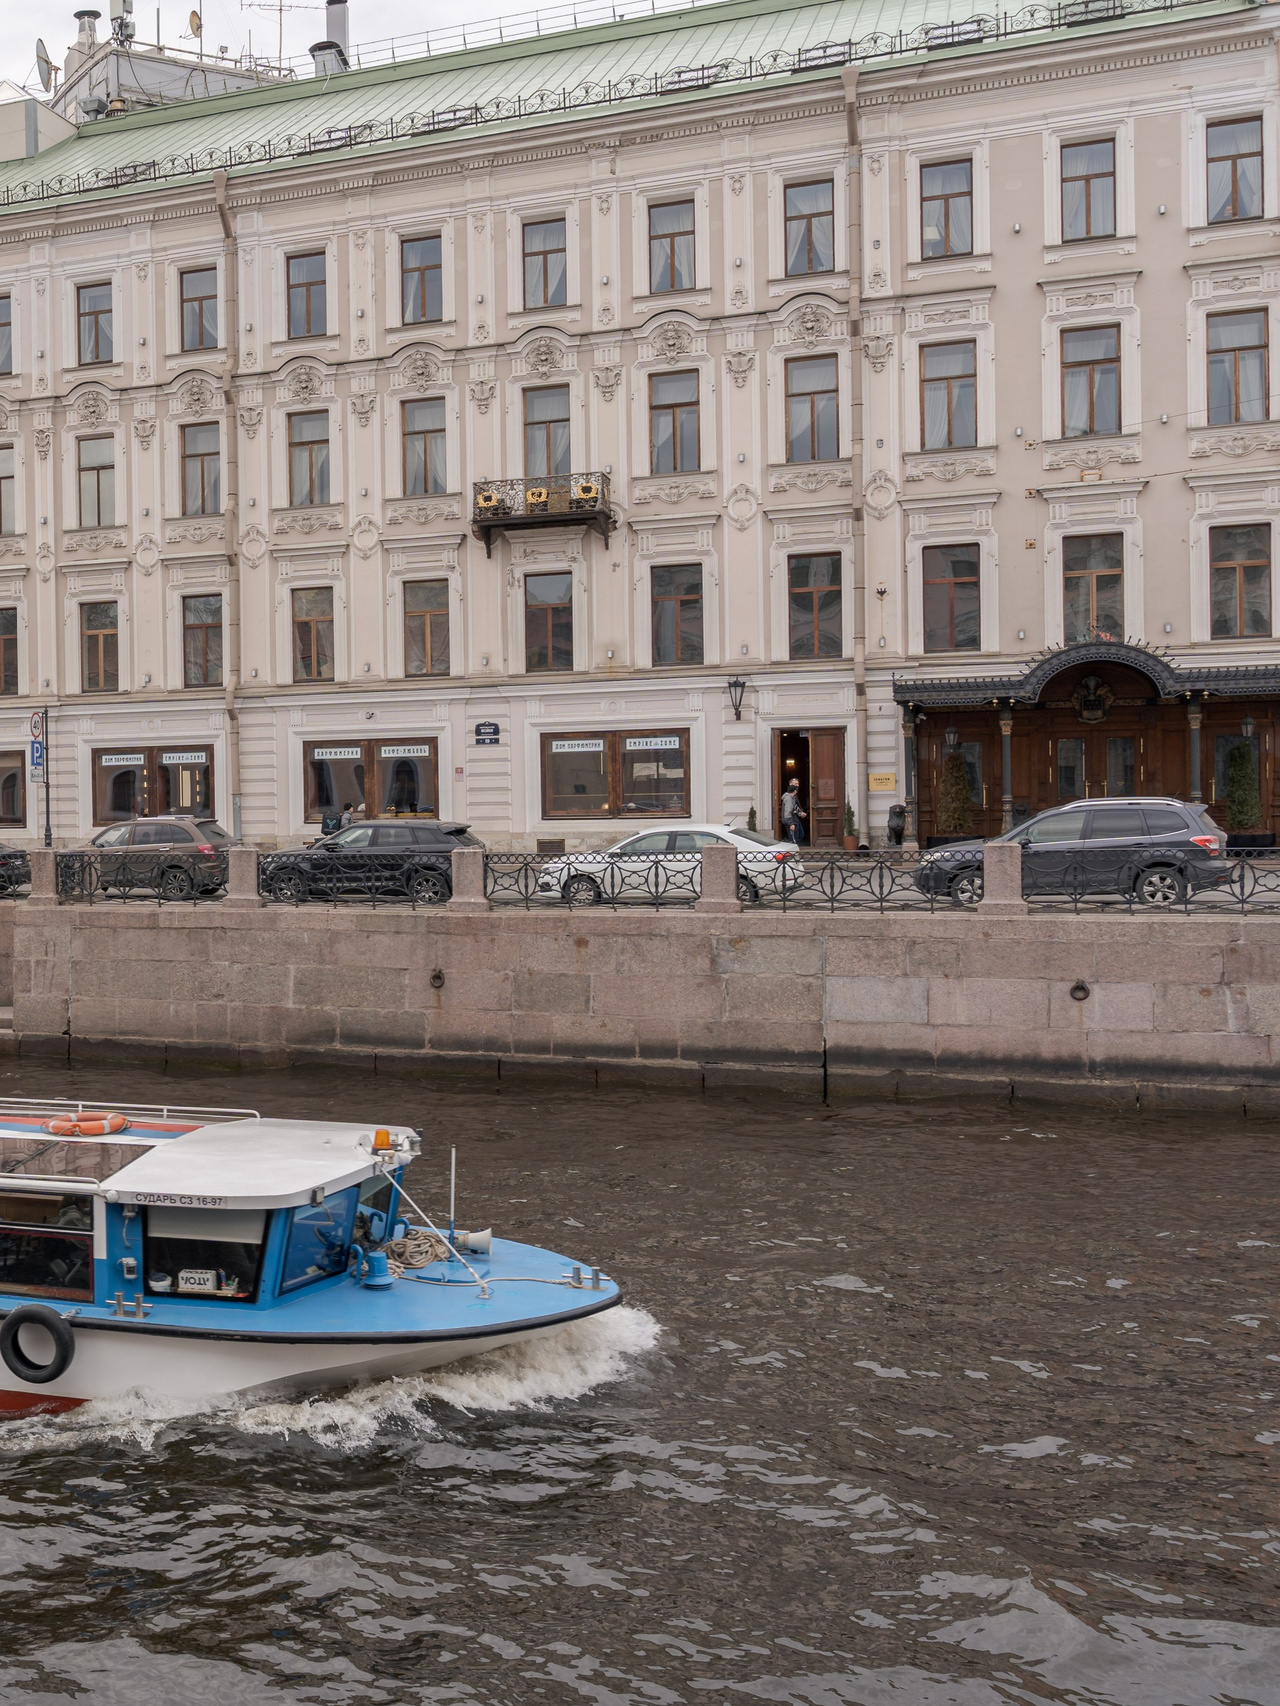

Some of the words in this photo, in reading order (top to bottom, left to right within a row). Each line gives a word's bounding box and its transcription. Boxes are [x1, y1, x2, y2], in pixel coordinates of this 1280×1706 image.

[33, 743, 42, 764] P
[135, 1193, 177, 1204] СУДАРЬ
[179, 1196, 194, 1205] СЗ
[196, 1197, 223, 1206] 16-97
